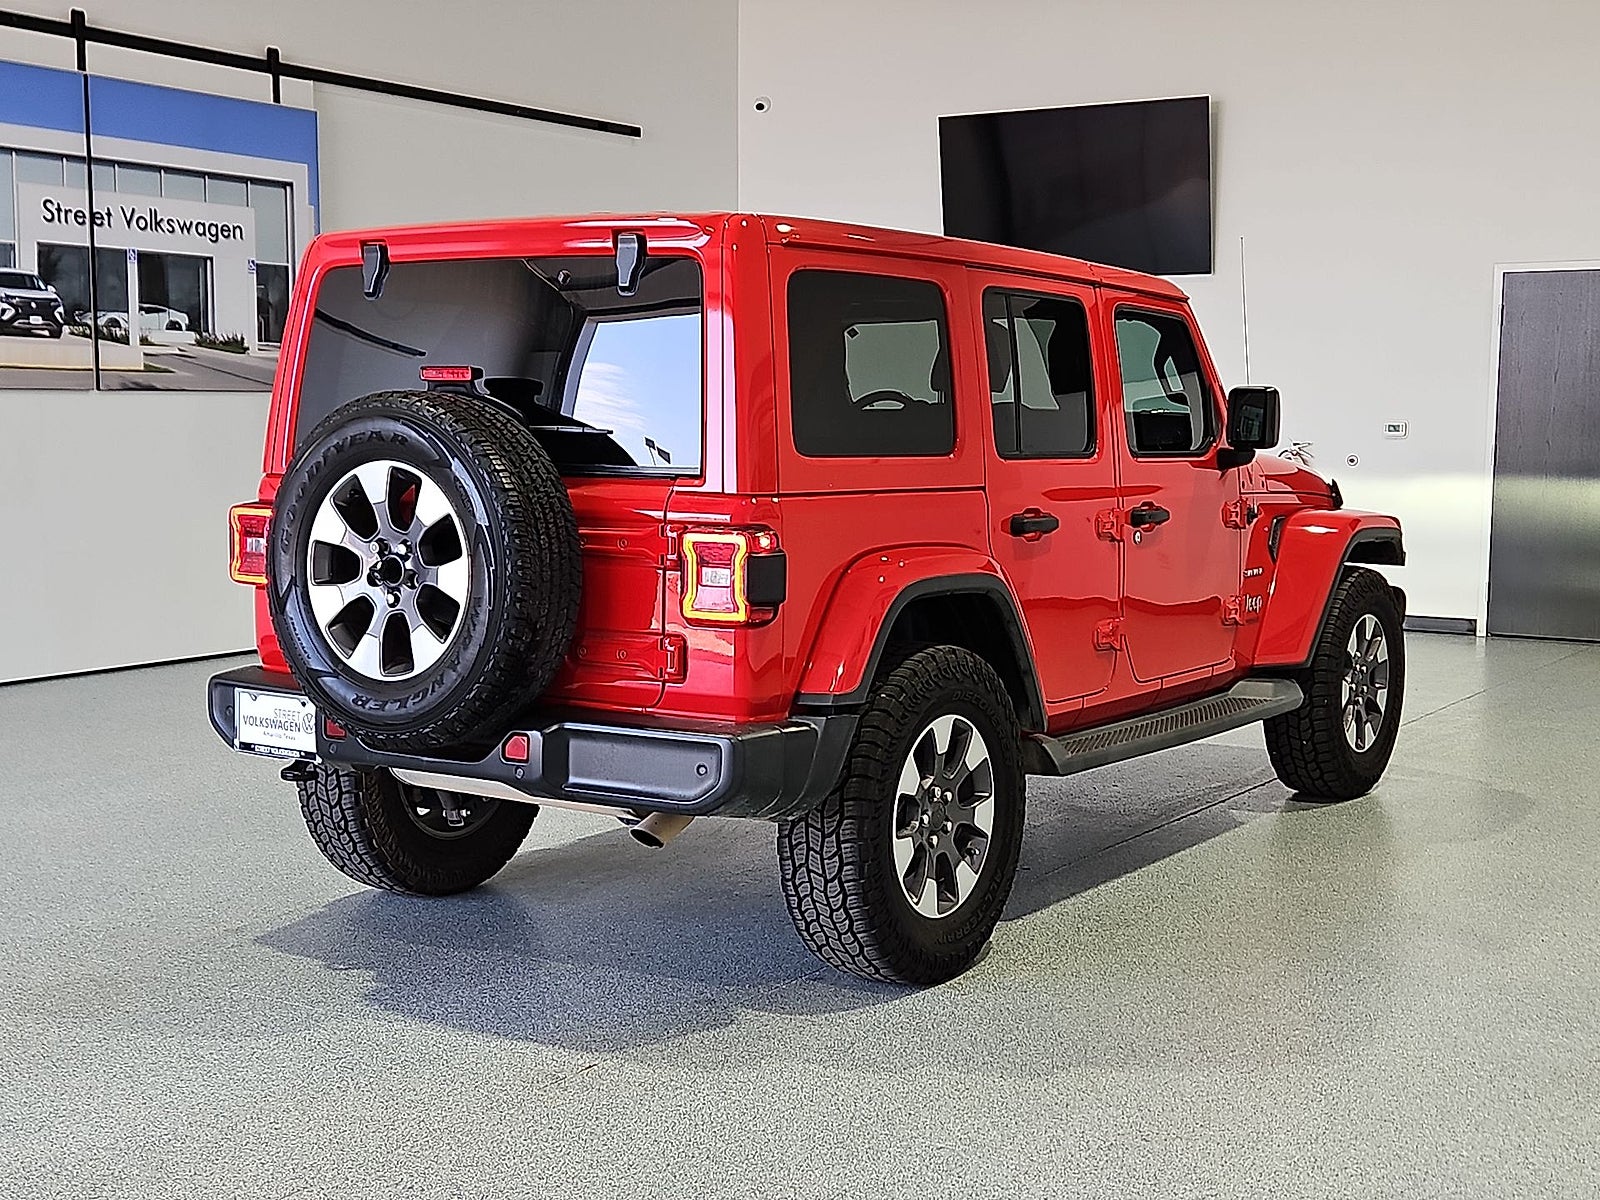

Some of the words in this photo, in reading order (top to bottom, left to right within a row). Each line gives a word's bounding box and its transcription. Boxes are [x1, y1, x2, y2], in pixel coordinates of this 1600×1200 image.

[41, 198, 114, 229] Street
[120, 205, 245, 243] Volkswagen
[280, 429, 409, 554] GOODYEAR
[242, 714, 301, 733] VOLKSWAGEN
[273, 707, 301, 722] STREET
